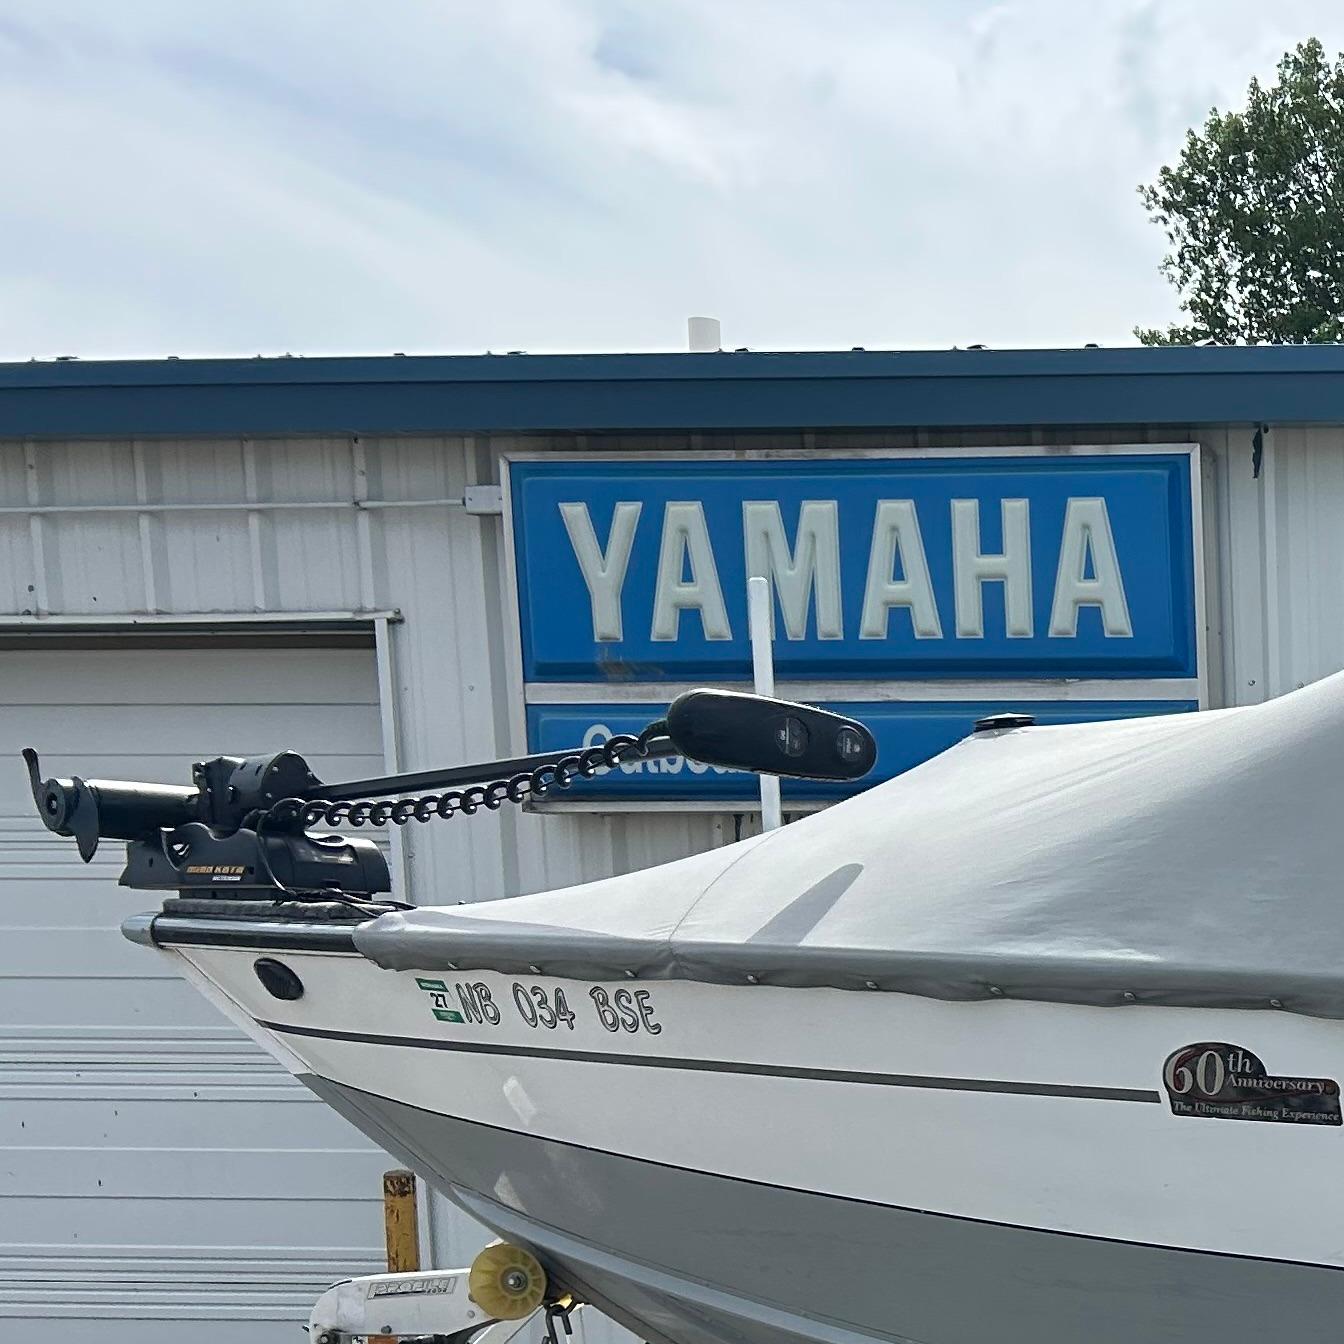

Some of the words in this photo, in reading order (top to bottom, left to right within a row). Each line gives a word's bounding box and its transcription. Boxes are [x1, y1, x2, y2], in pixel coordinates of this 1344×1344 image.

[558, 497, 1133, 642] YAMAHA
[455, 982, 500, 1026] NB
[512, 982, 576, 1031] 034
[589, 985, 662, 1035] BSE
[1225, 1074, 1325, 1096] Anniversary
[1173, 1101, 1192, 1112] The
[1282, 1107, 1340, 1121] Experience
